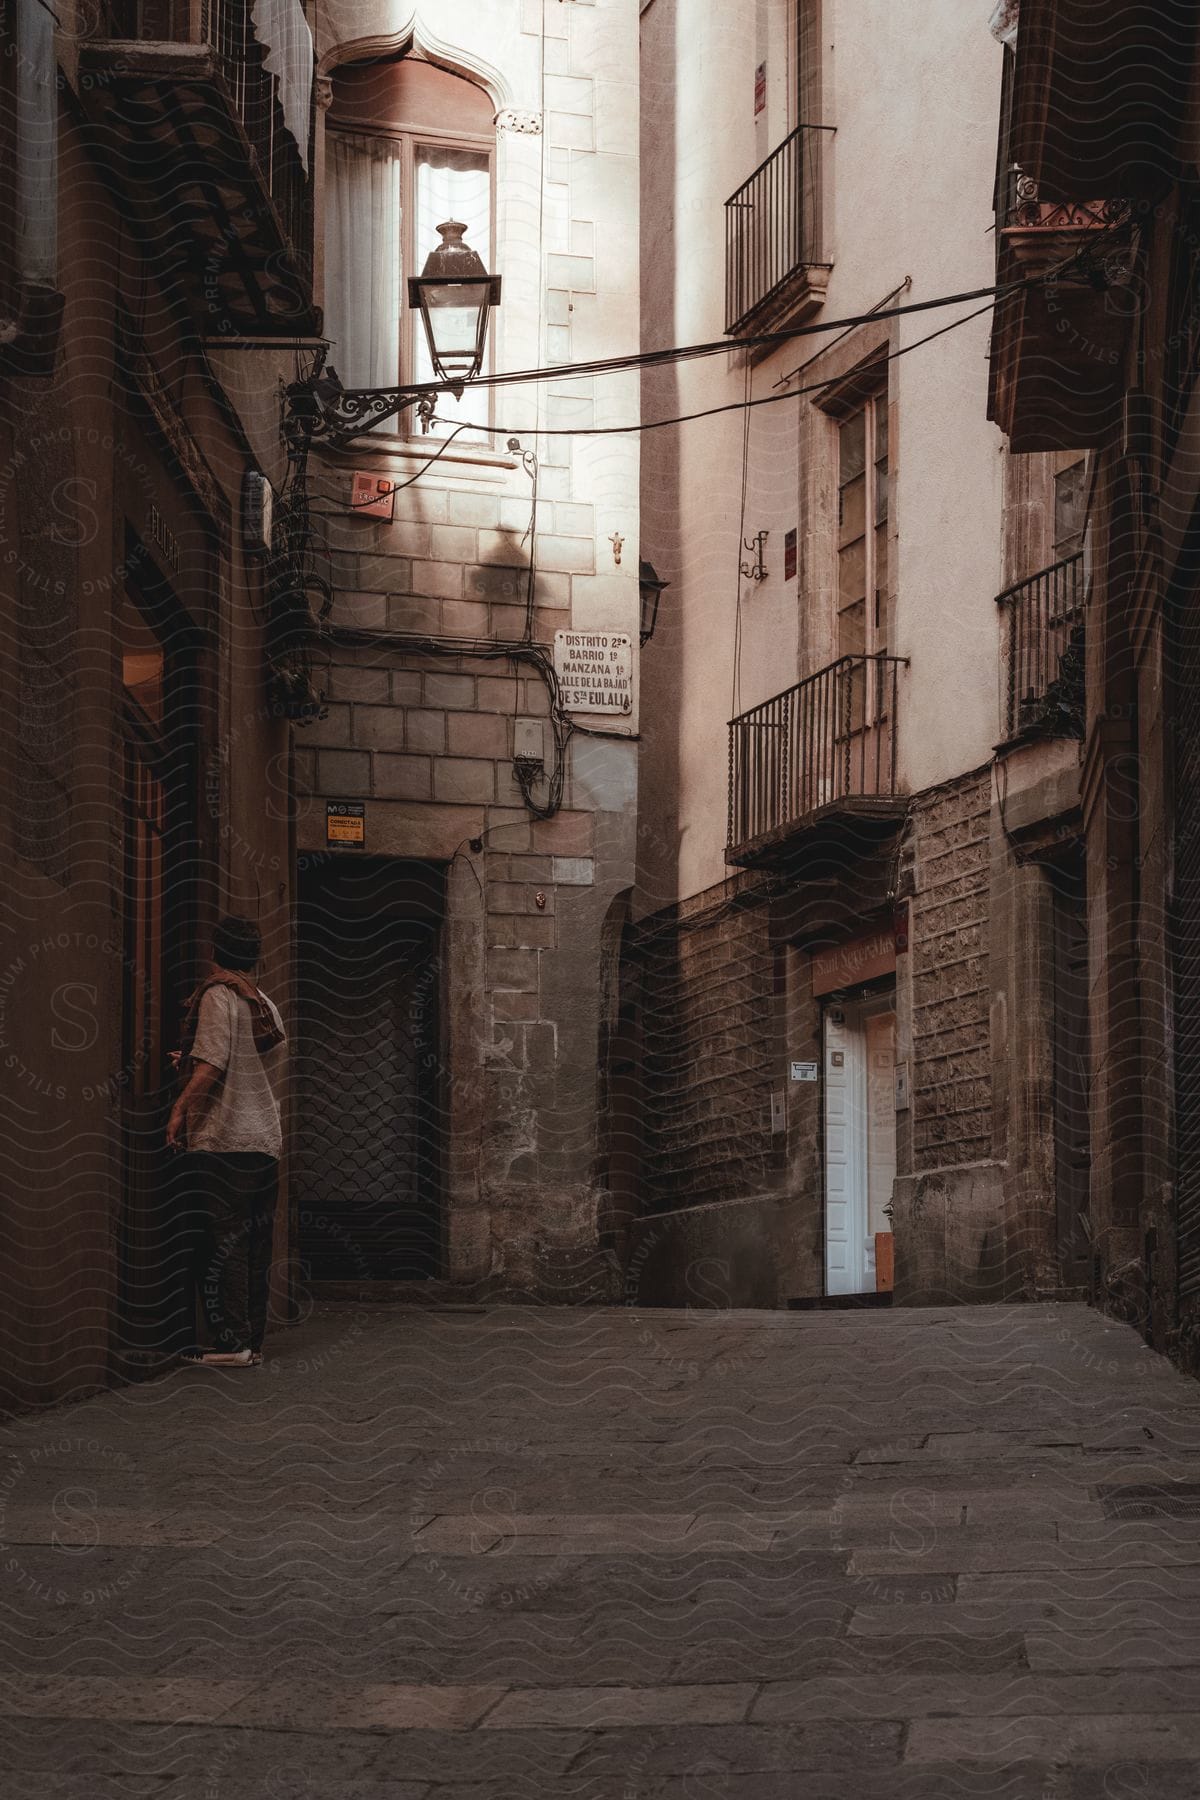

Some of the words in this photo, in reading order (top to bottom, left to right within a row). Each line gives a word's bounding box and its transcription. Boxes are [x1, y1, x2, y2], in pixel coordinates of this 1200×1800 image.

[566, 635, 608, 647] DISTRITO
[569, 650, 605, 661] BARRIO
[563, 663, 611, 675] MANZANA
[581, 677, 590, 687] DE
[592, 678, 602, 688] LA
[559, 690, 571, 704] DE
[589, 692, 630, 707] EULALIA
